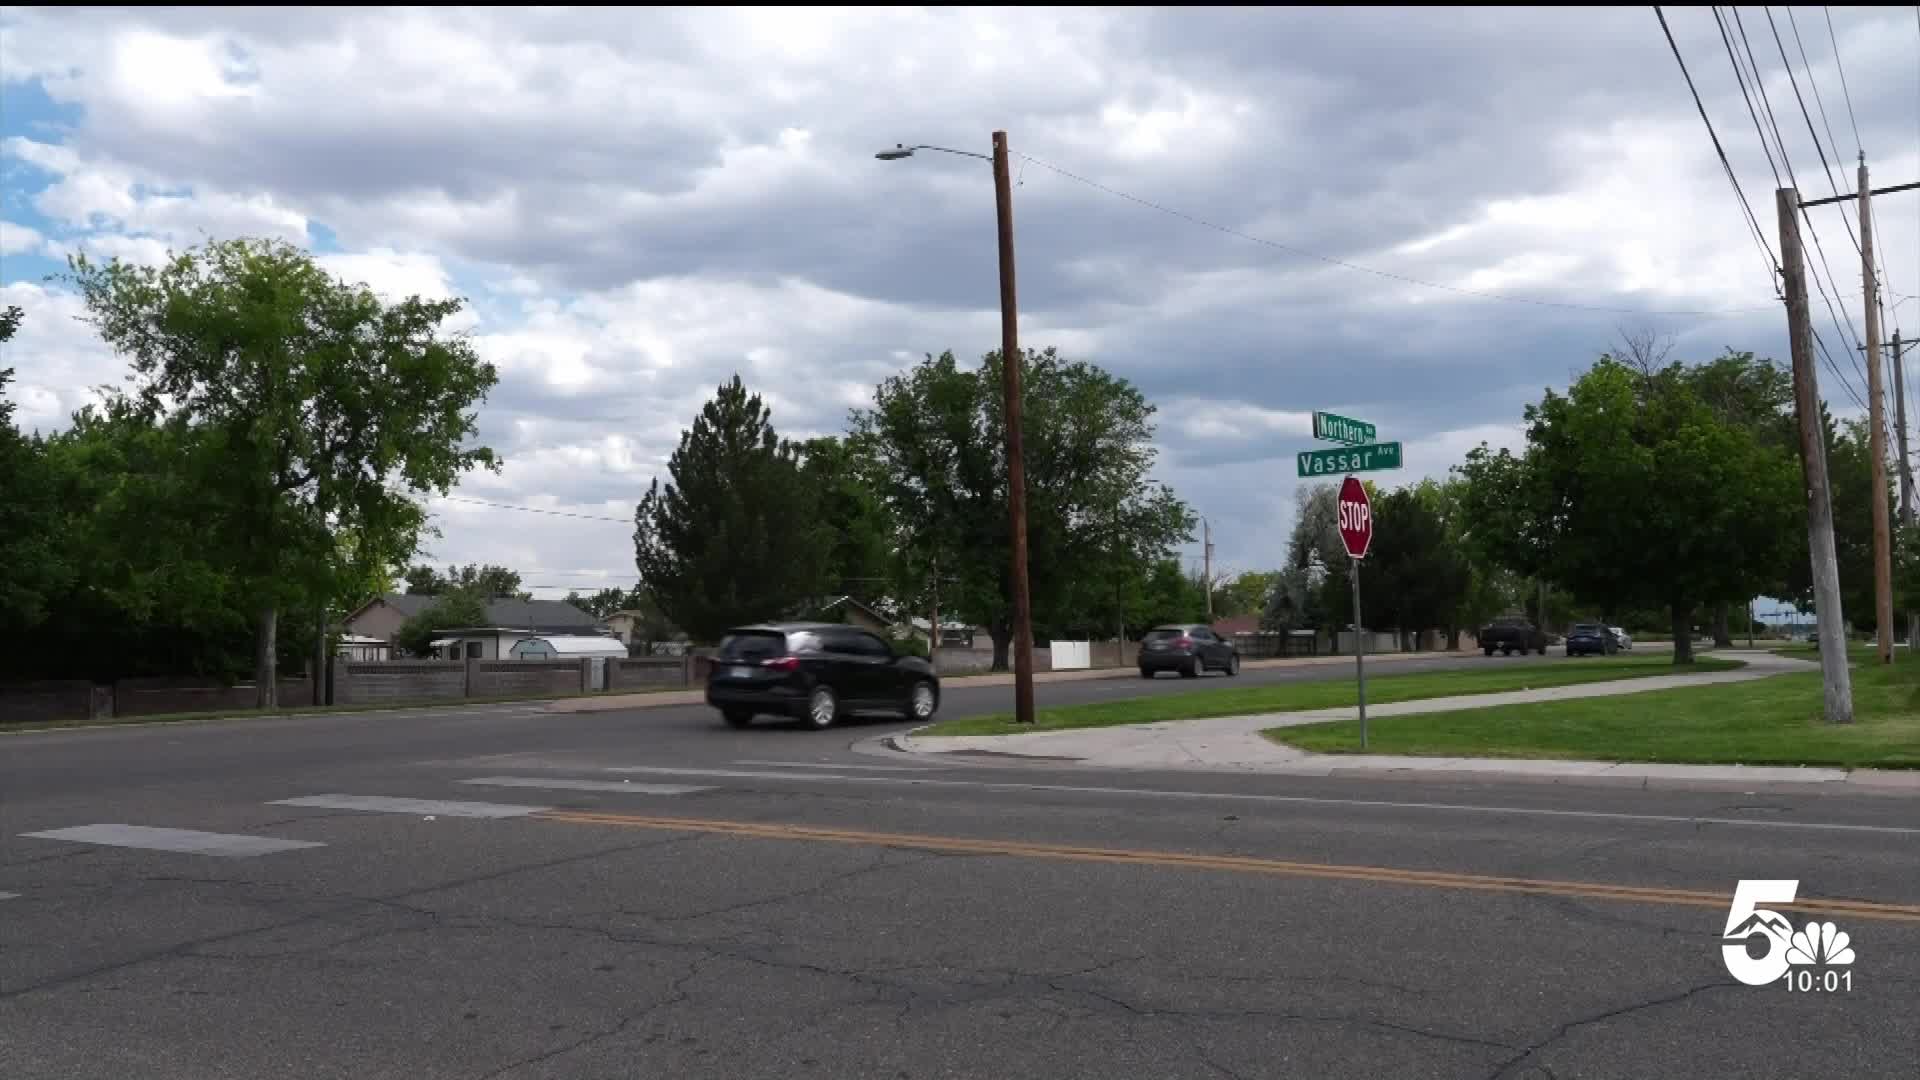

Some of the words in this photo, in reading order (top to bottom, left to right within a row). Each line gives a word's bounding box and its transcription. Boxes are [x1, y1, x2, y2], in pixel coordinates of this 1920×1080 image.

[1320, 415, 1364, 443] Northern
[1301, 452, 1373, 473] Vassar
[1377, 446, 1394, 456] Ave
[1340, 501, 1369, 532] STOP
